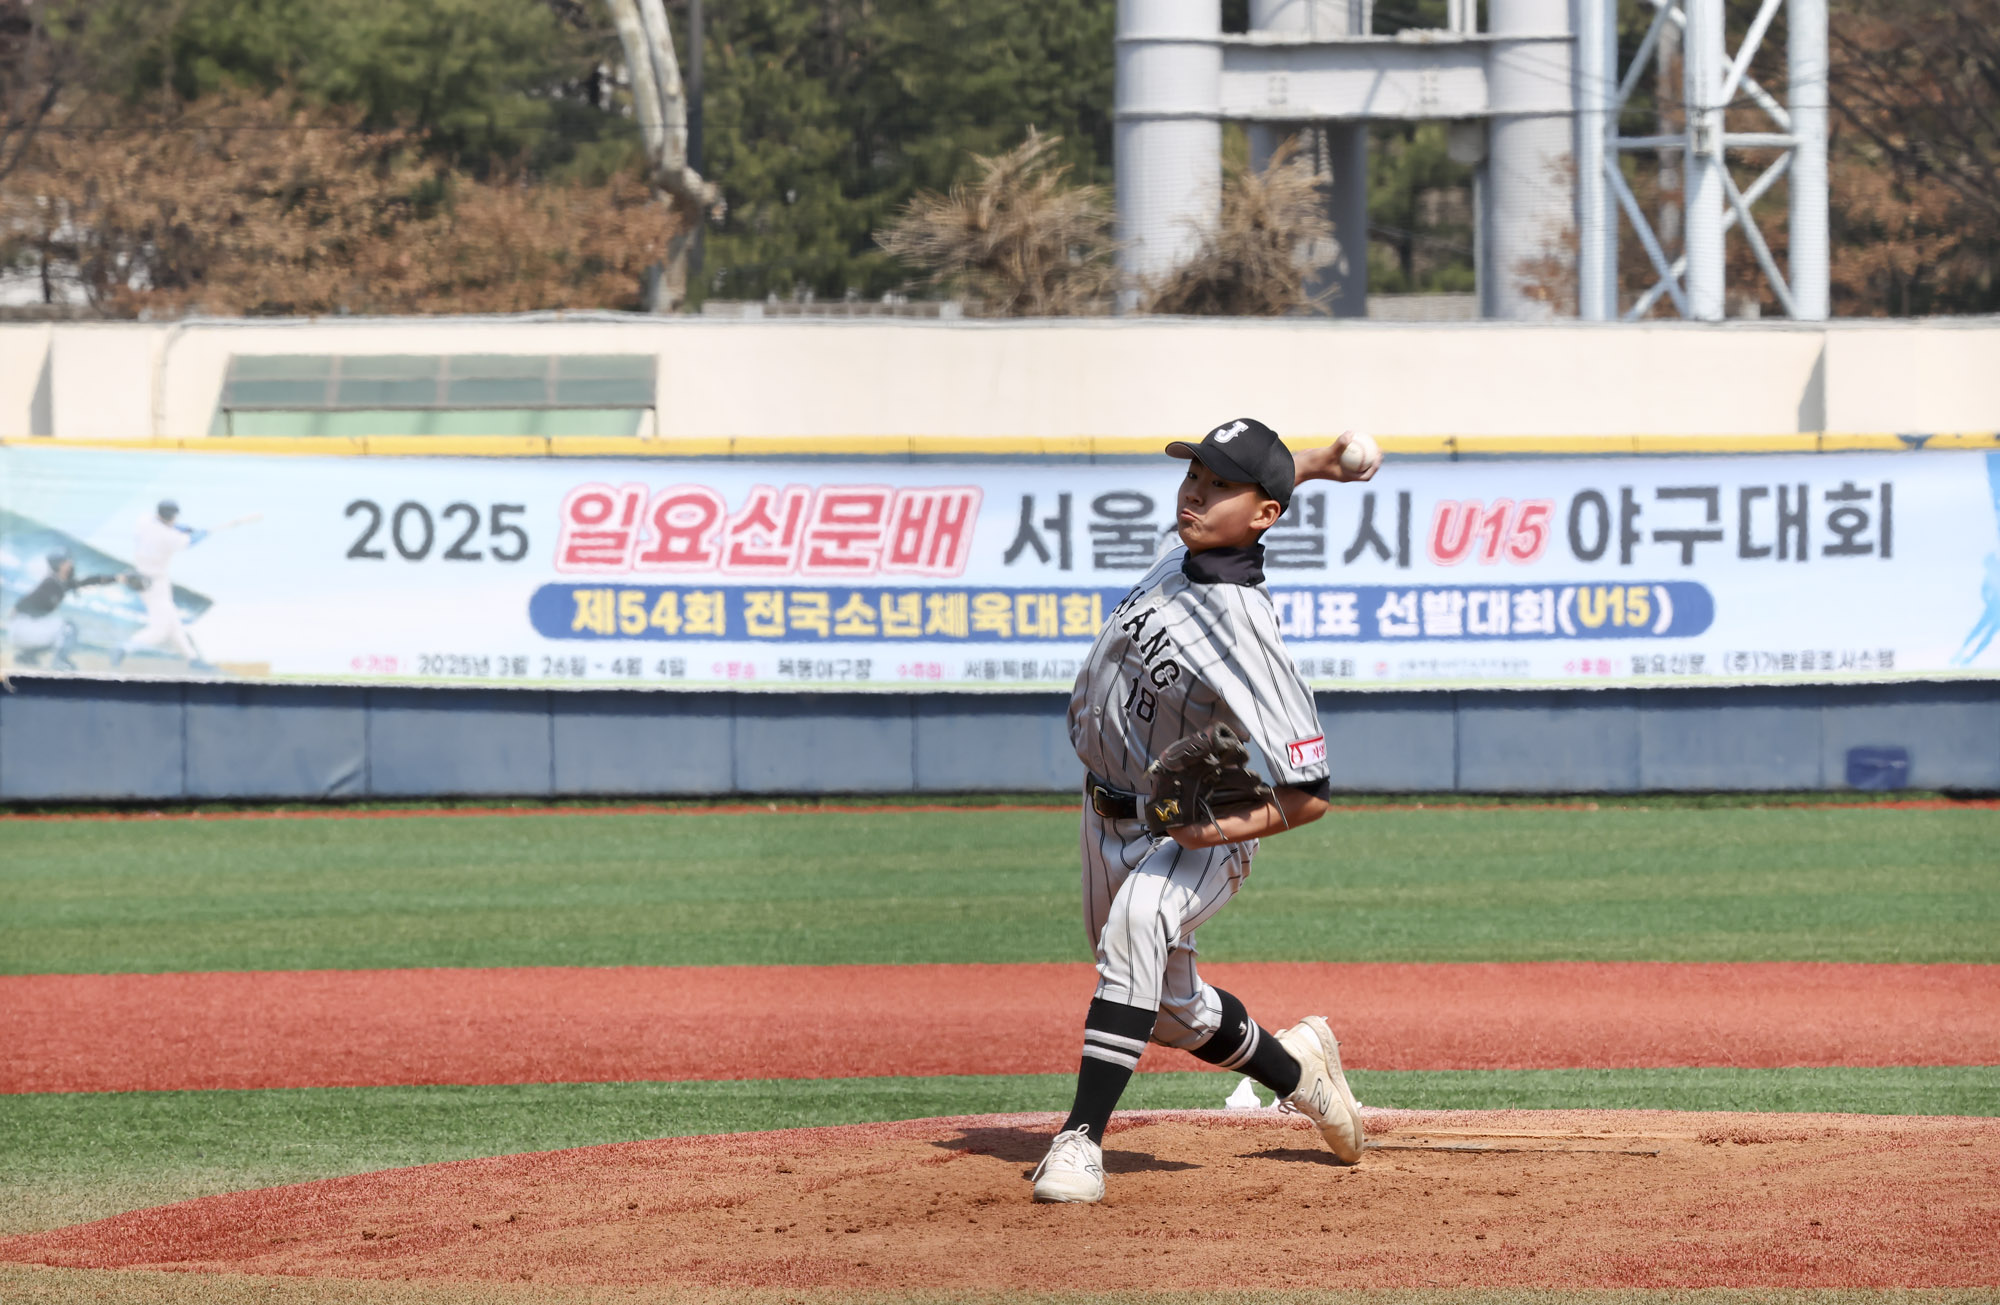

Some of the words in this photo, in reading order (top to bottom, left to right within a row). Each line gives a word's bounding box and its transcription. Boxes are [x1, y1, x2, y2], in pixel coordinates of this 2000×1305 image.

[1213, 420, 1249, 444] J
[344, 500, 529, 562] 2025
[556, 484, 978, 576] 일요신문배
[1003, 490, 1412, 570] 서울별시
[1428, 498, 1556, 567] U15
[1567, 481, 1893, 566] 야구대회
[571, 589, 725, 636] 제54회
[743, 591, 1102, 640] 전국소년체육대회
[1376, 586, 1673, 638] 선발대회(U15)
[418, 654, 490, 676] 2025년
[497, 655, 529, 676] 3월
[542, 654, 586, 677] 26일
[611, 656, 643, 677] 4월
[656, 657, 686, 677] 4일
[963, 659, 1087, 680] 서울특별시교
[1124, 677, 1156, 723] 18
